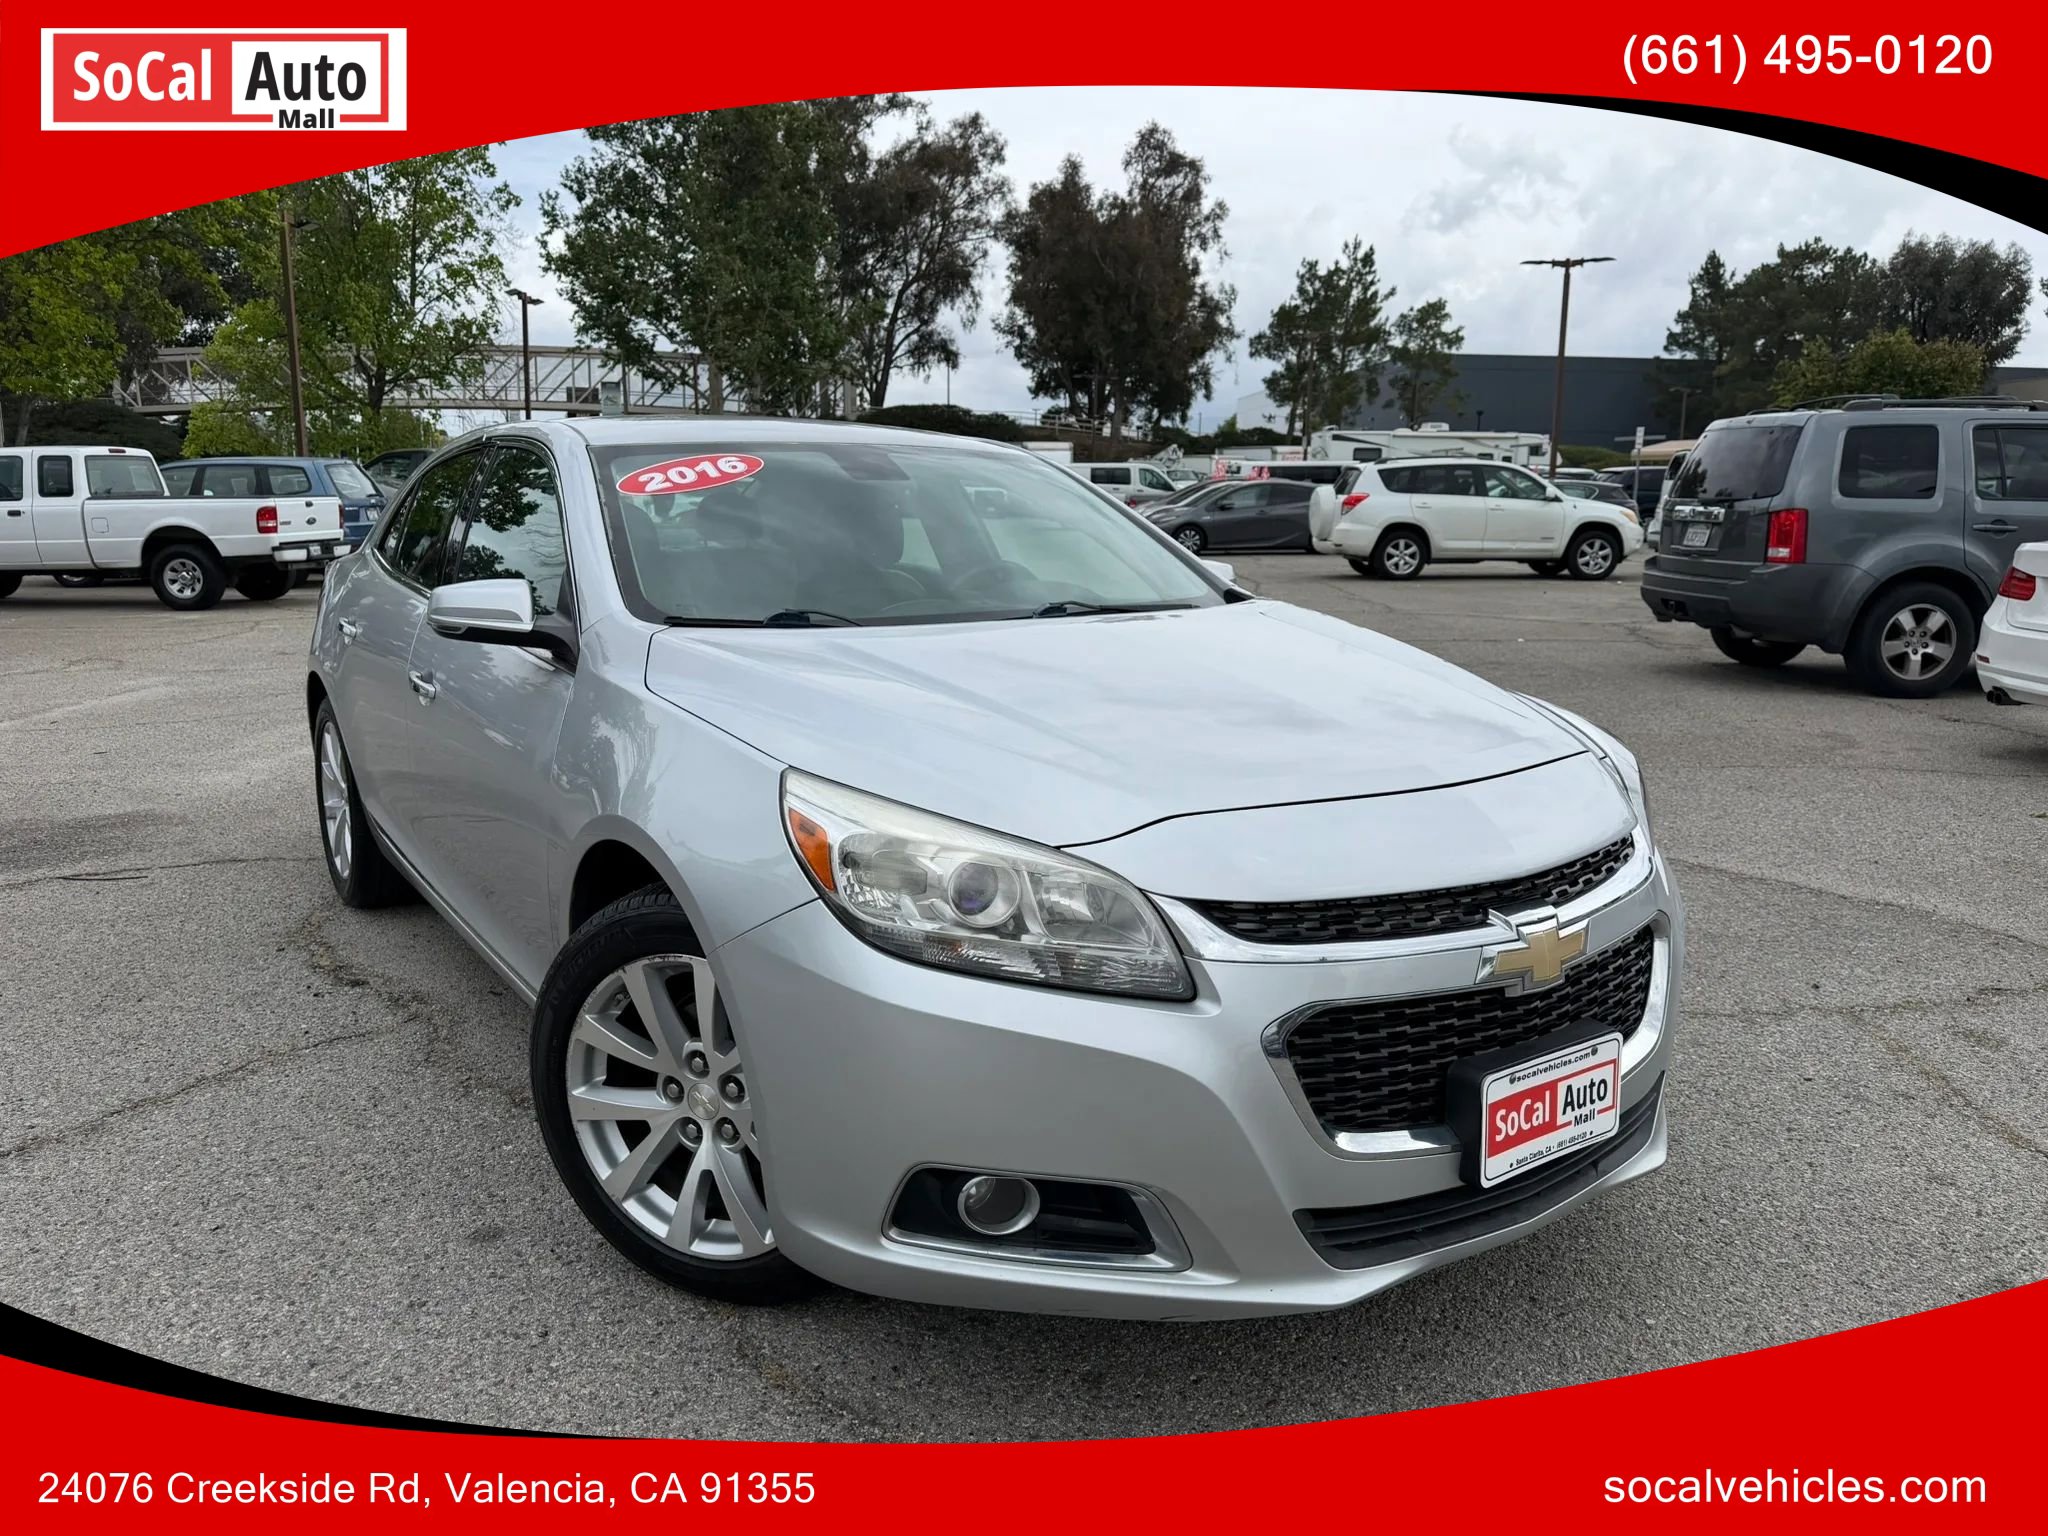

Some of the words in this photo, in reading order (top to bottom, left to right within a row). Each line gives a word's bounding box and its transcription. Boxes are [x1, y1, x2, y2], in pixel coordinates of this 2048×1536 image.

[638, 456, 748, 492] 2016
[1516, 1051, 1591, 1082] socalvehicles.com
[1495, 1091, 1550, 1142] SoCal
[1562, 1077, 1608, 1116] Auto
[1573, 1108, 1596, 1128] Mall
